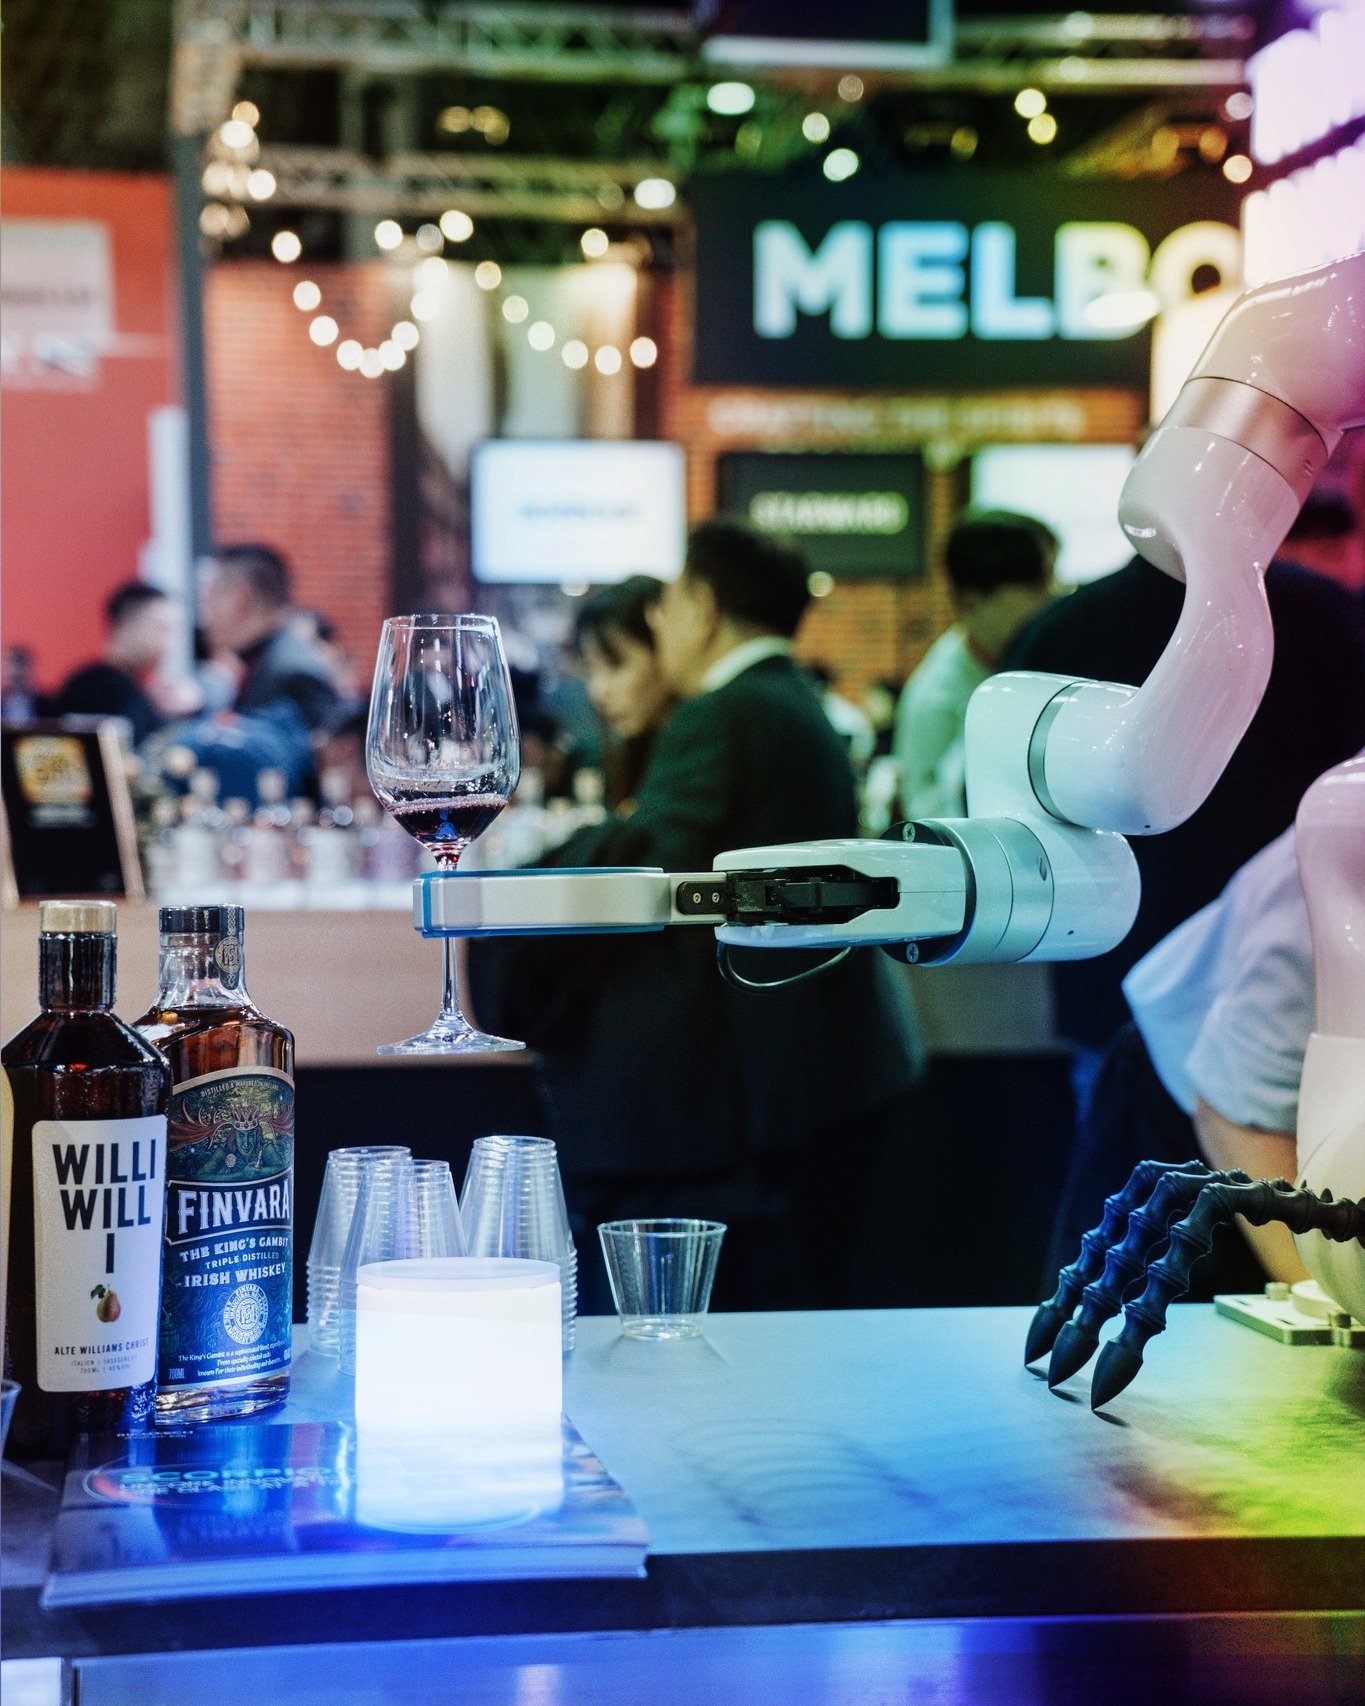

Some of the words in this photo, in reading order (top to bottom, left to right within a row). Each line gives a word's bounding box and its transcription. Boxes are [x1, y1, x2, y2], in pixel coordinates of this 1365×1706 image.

[52, 1139, 156, 1185] WILLI
[60, 1185, 151, 1230] WILL
[178, 1179, 290, 1234] FINVARA
[105, 1232, 115, 1274] I
[180, 1246, 210, 1262] THE
[214, 1237, 256, 1255] KING'S
[259, 1236, 289, 1248] GAMBIT
[205, 1255, 240, 1269] TRIPLE
[242, 1251, 280, 1262] DISTILLED
[184, 1271, 230, 1287] IRISH
[234, 1261, 286, 1282] WHISKEY
[54, 1346, 76, 1355] ALTE
[80, 1343, 123, 1354] WILLIAMS
[125, 1337, 149, 1350] CHRIST
